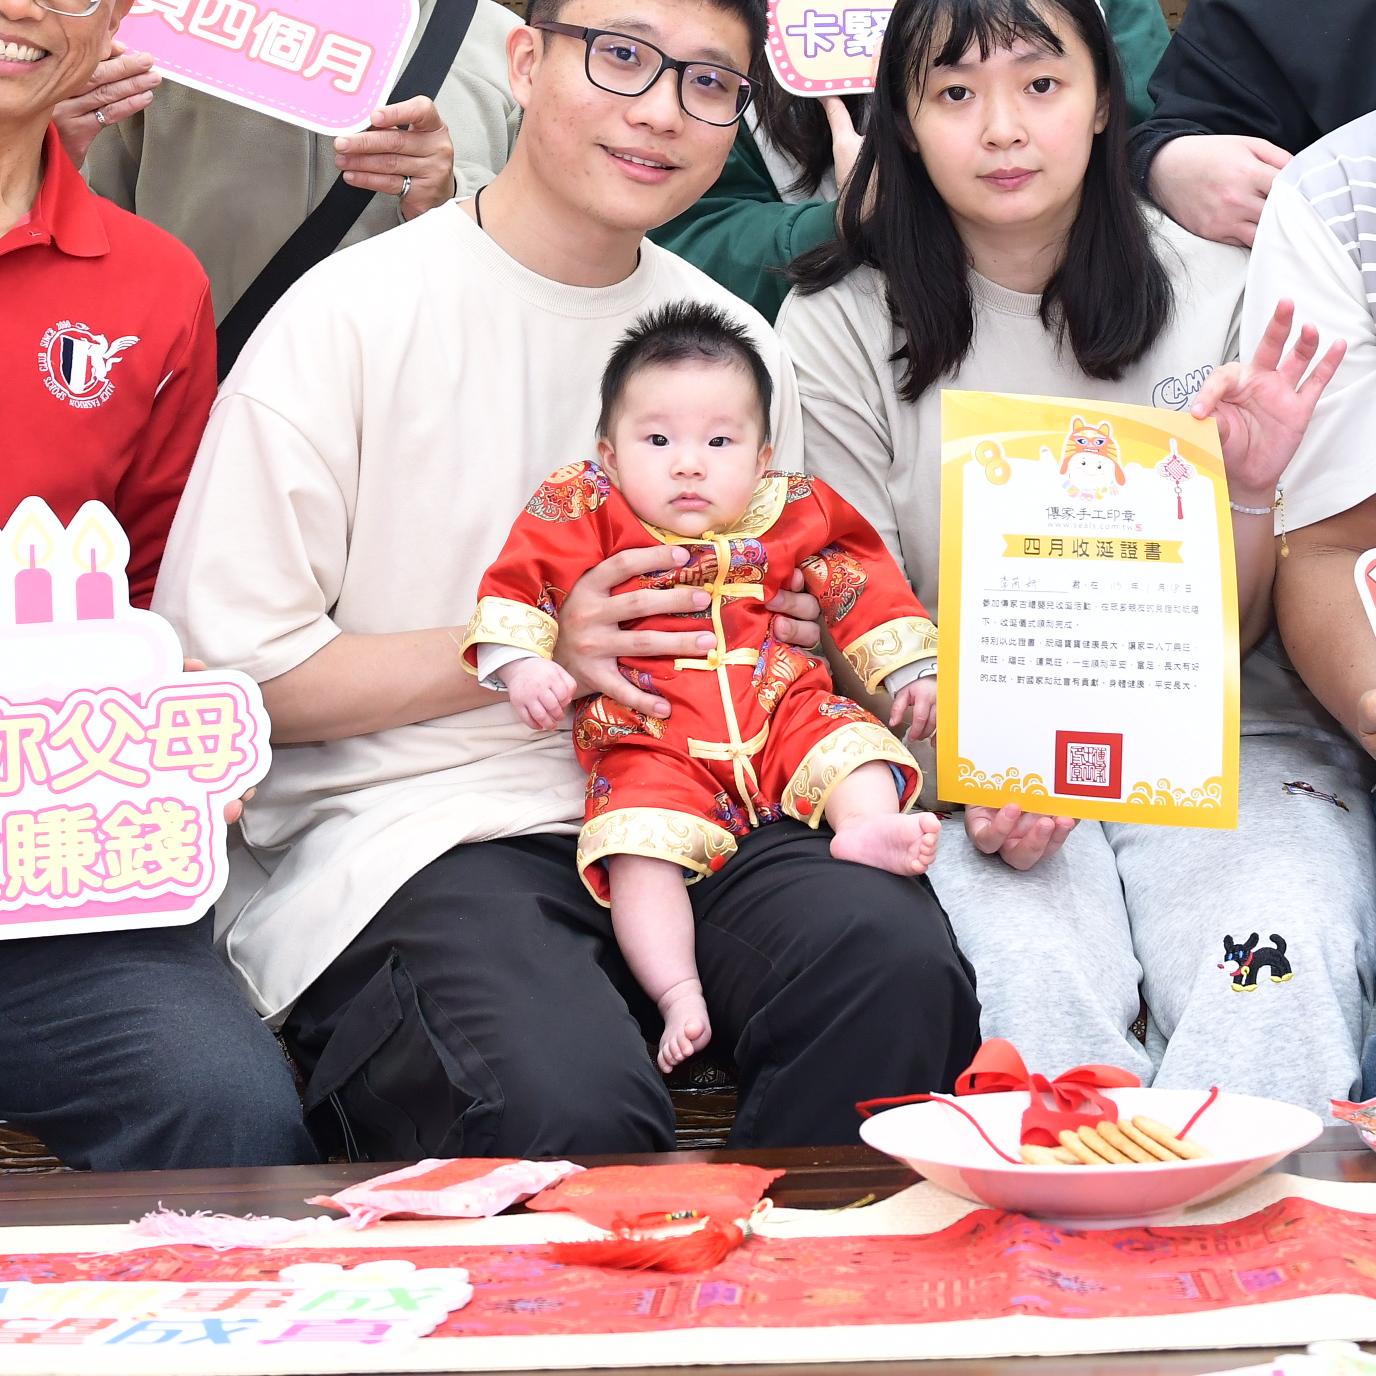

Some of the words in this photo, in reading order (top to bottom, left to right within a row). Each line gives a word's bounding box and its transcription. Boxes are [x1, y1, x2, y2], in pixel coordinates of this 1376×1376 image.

[39, 327, 57, 348] SINCE
[37, 352, 49, 372] CLUB
[43, 376, 67, 401] SPORTS
[1045, 506, 1136, 523] 傳家手工印章
[1023, 537, 1162, 561] 四月收涎證書
